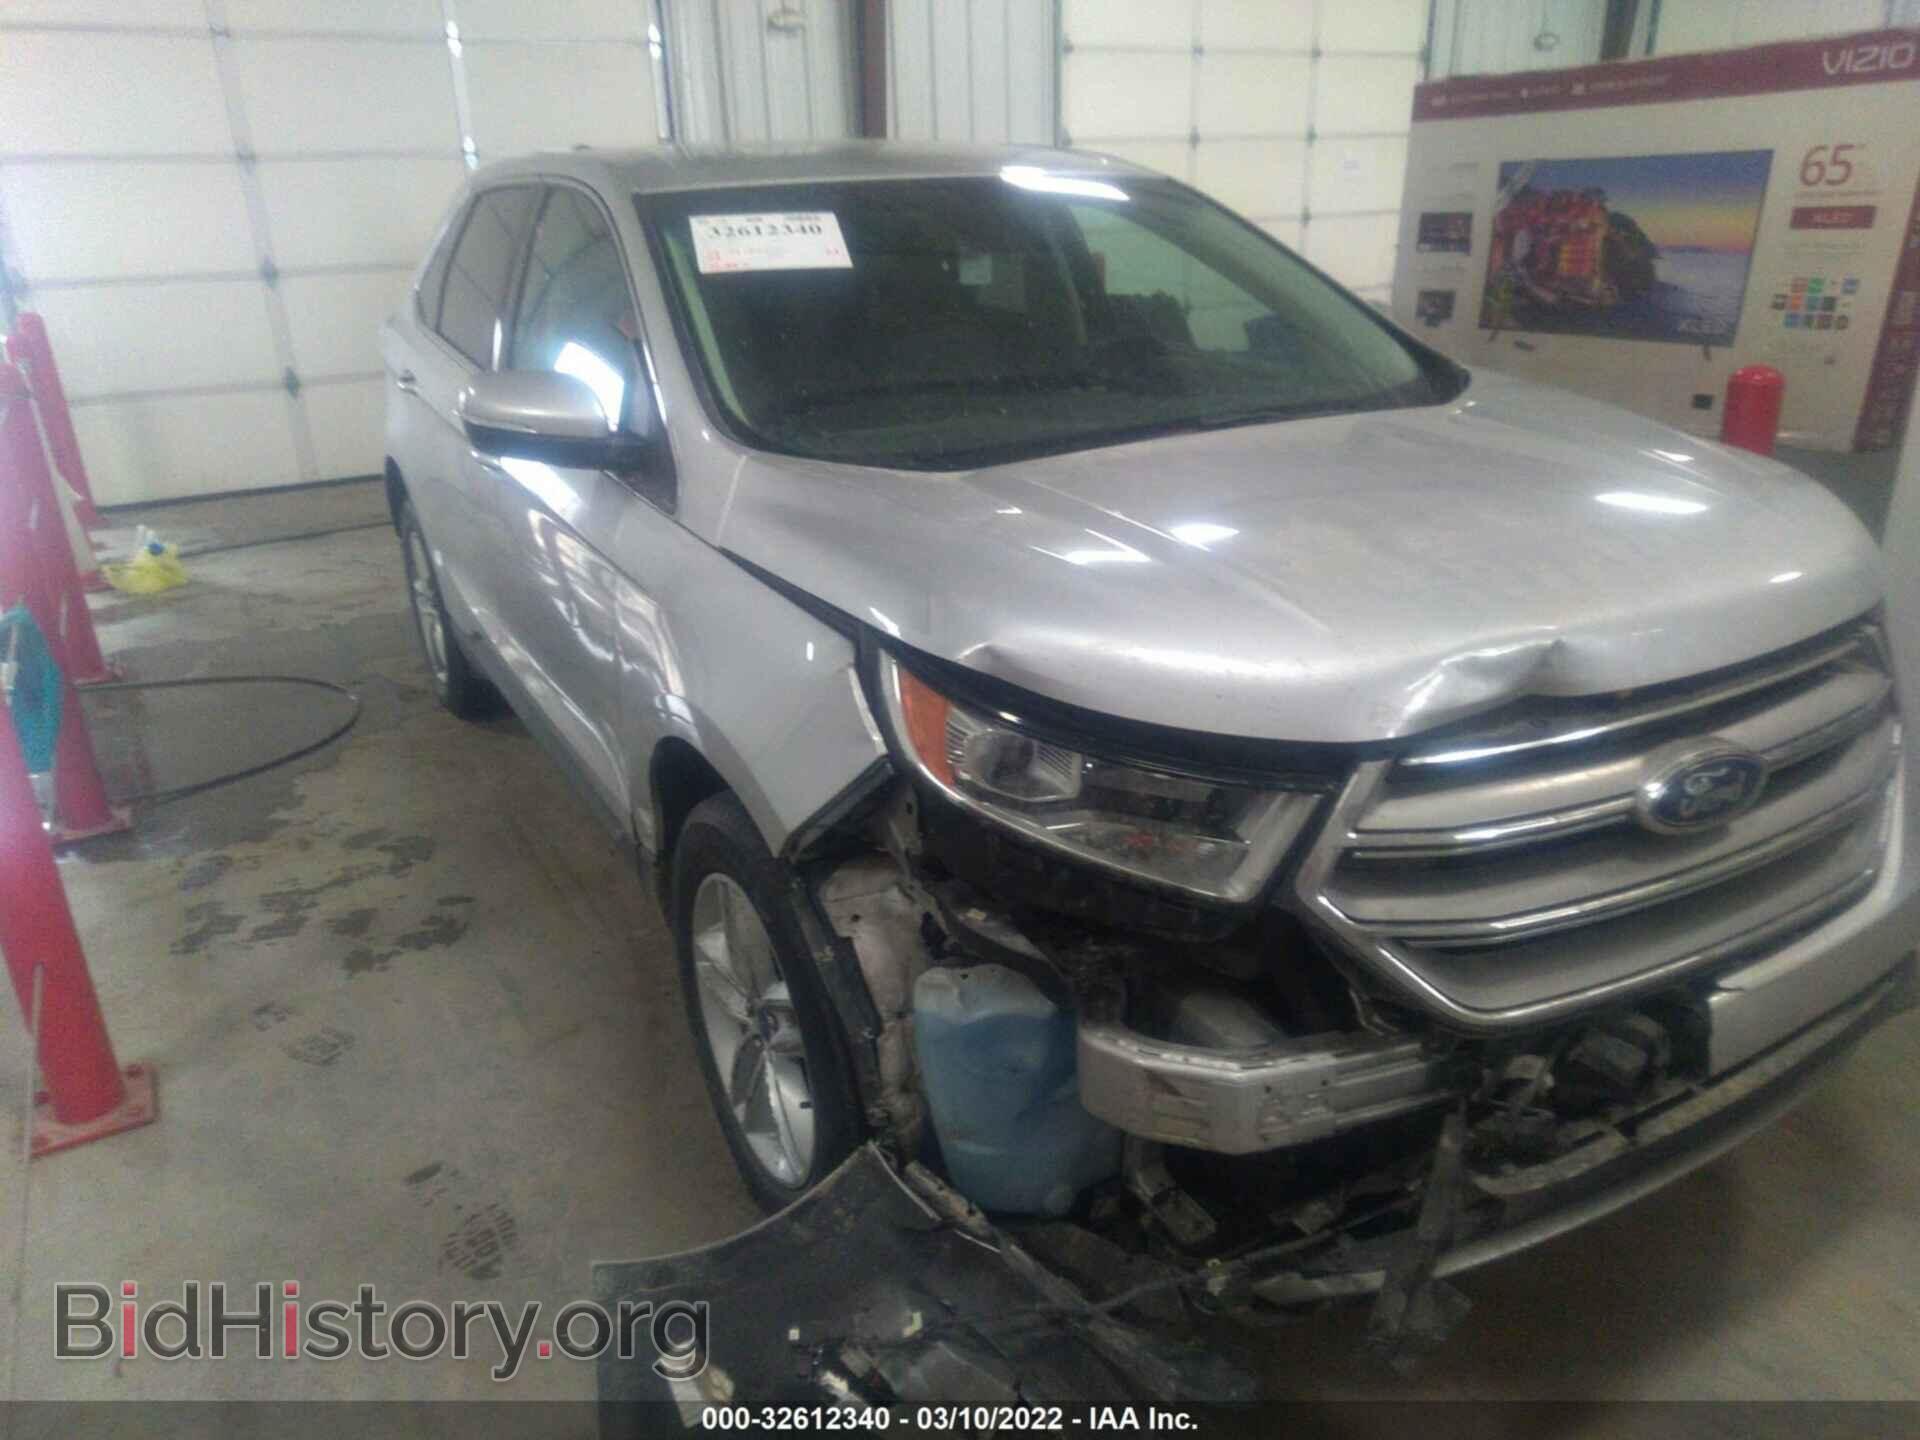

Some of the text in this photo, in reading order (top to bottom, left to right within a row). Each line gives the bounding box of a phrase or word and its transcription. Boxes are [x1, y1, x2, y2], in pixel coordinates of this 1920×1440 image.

[1823, 43, 1915, 75] VIZIO
[1800, 143, 1856, 187] 65
[708, 222, 823, 239] 32612340
